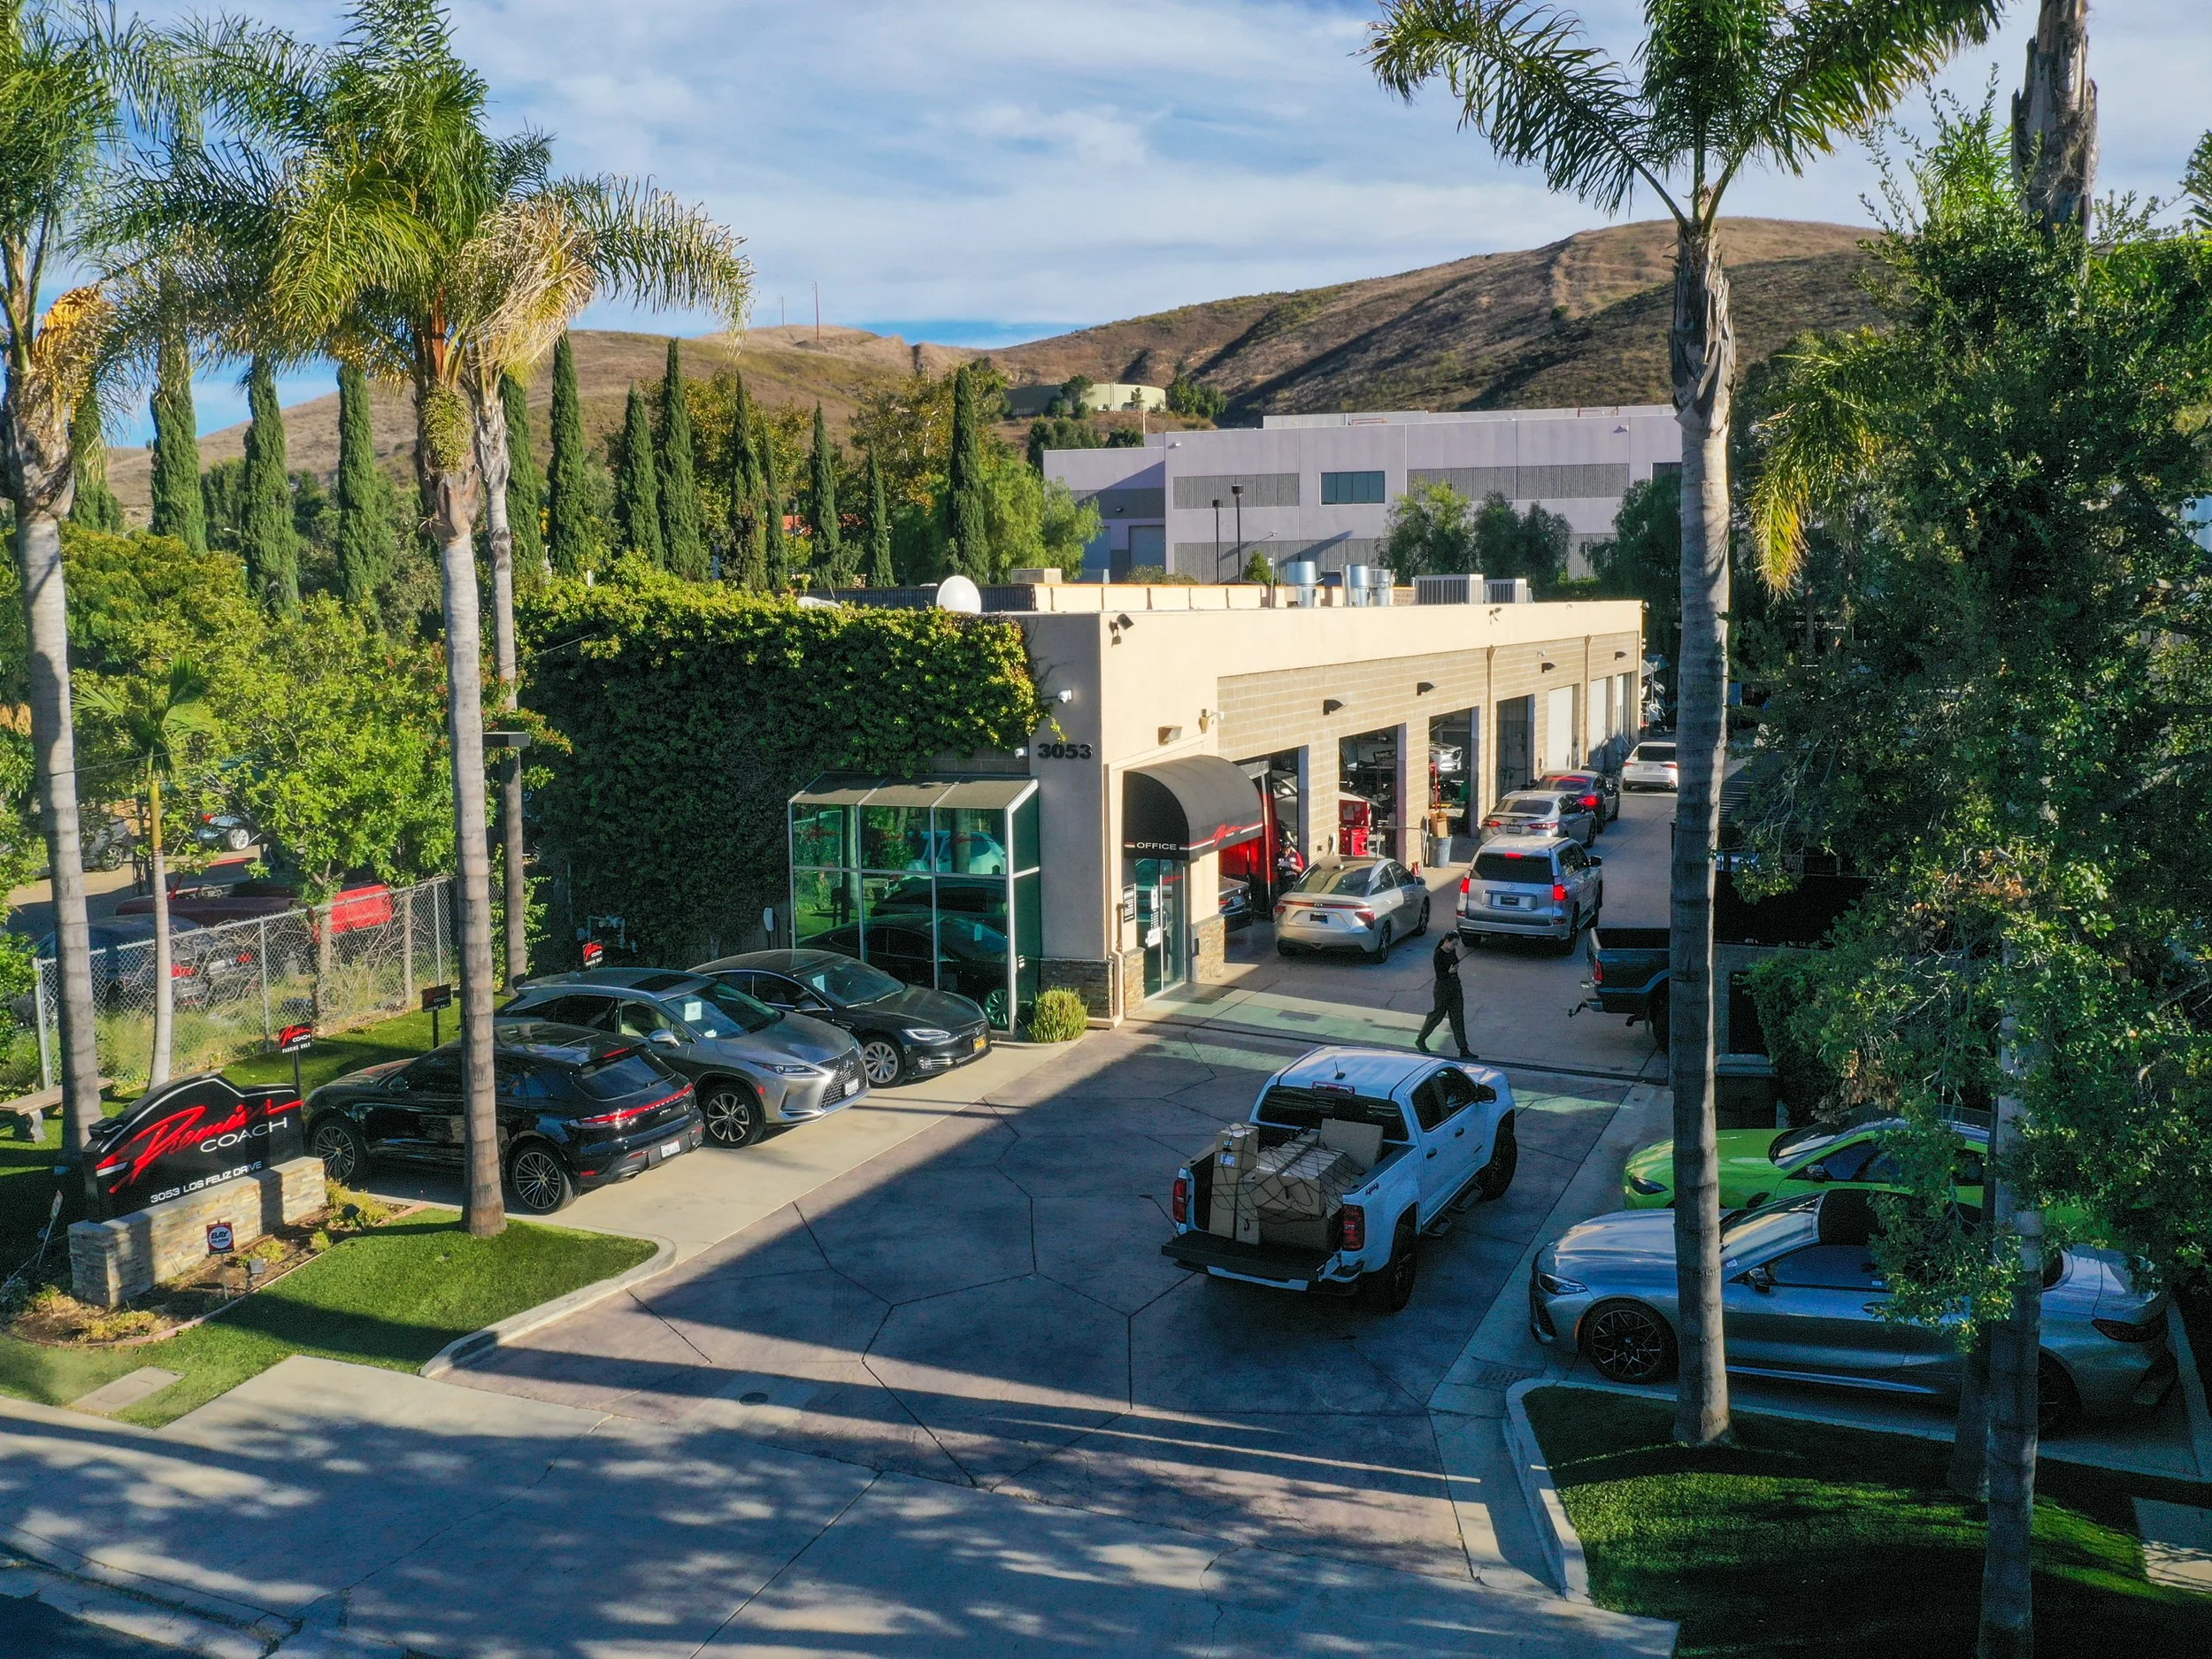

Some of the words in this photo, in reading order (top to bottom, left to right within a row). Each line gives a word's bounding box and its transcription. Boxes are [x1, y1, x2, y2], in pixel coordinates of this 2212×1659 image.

[1038, 743, 1092, 759] 3053
[1136, 841, 1177, 850] OFFICE
[292, 1033, 311, 1042] COACH
[200, 1117, 288, 1153] COACH
[150, 1188, 180, 1203] 3053
[183, 1179, 204, 1194] LOS
[205, 1171, 232, 1187] FELIZ
[233, 1161, 262, 1177] DRIVE
[211, 1231, 228, 1240] BAY
